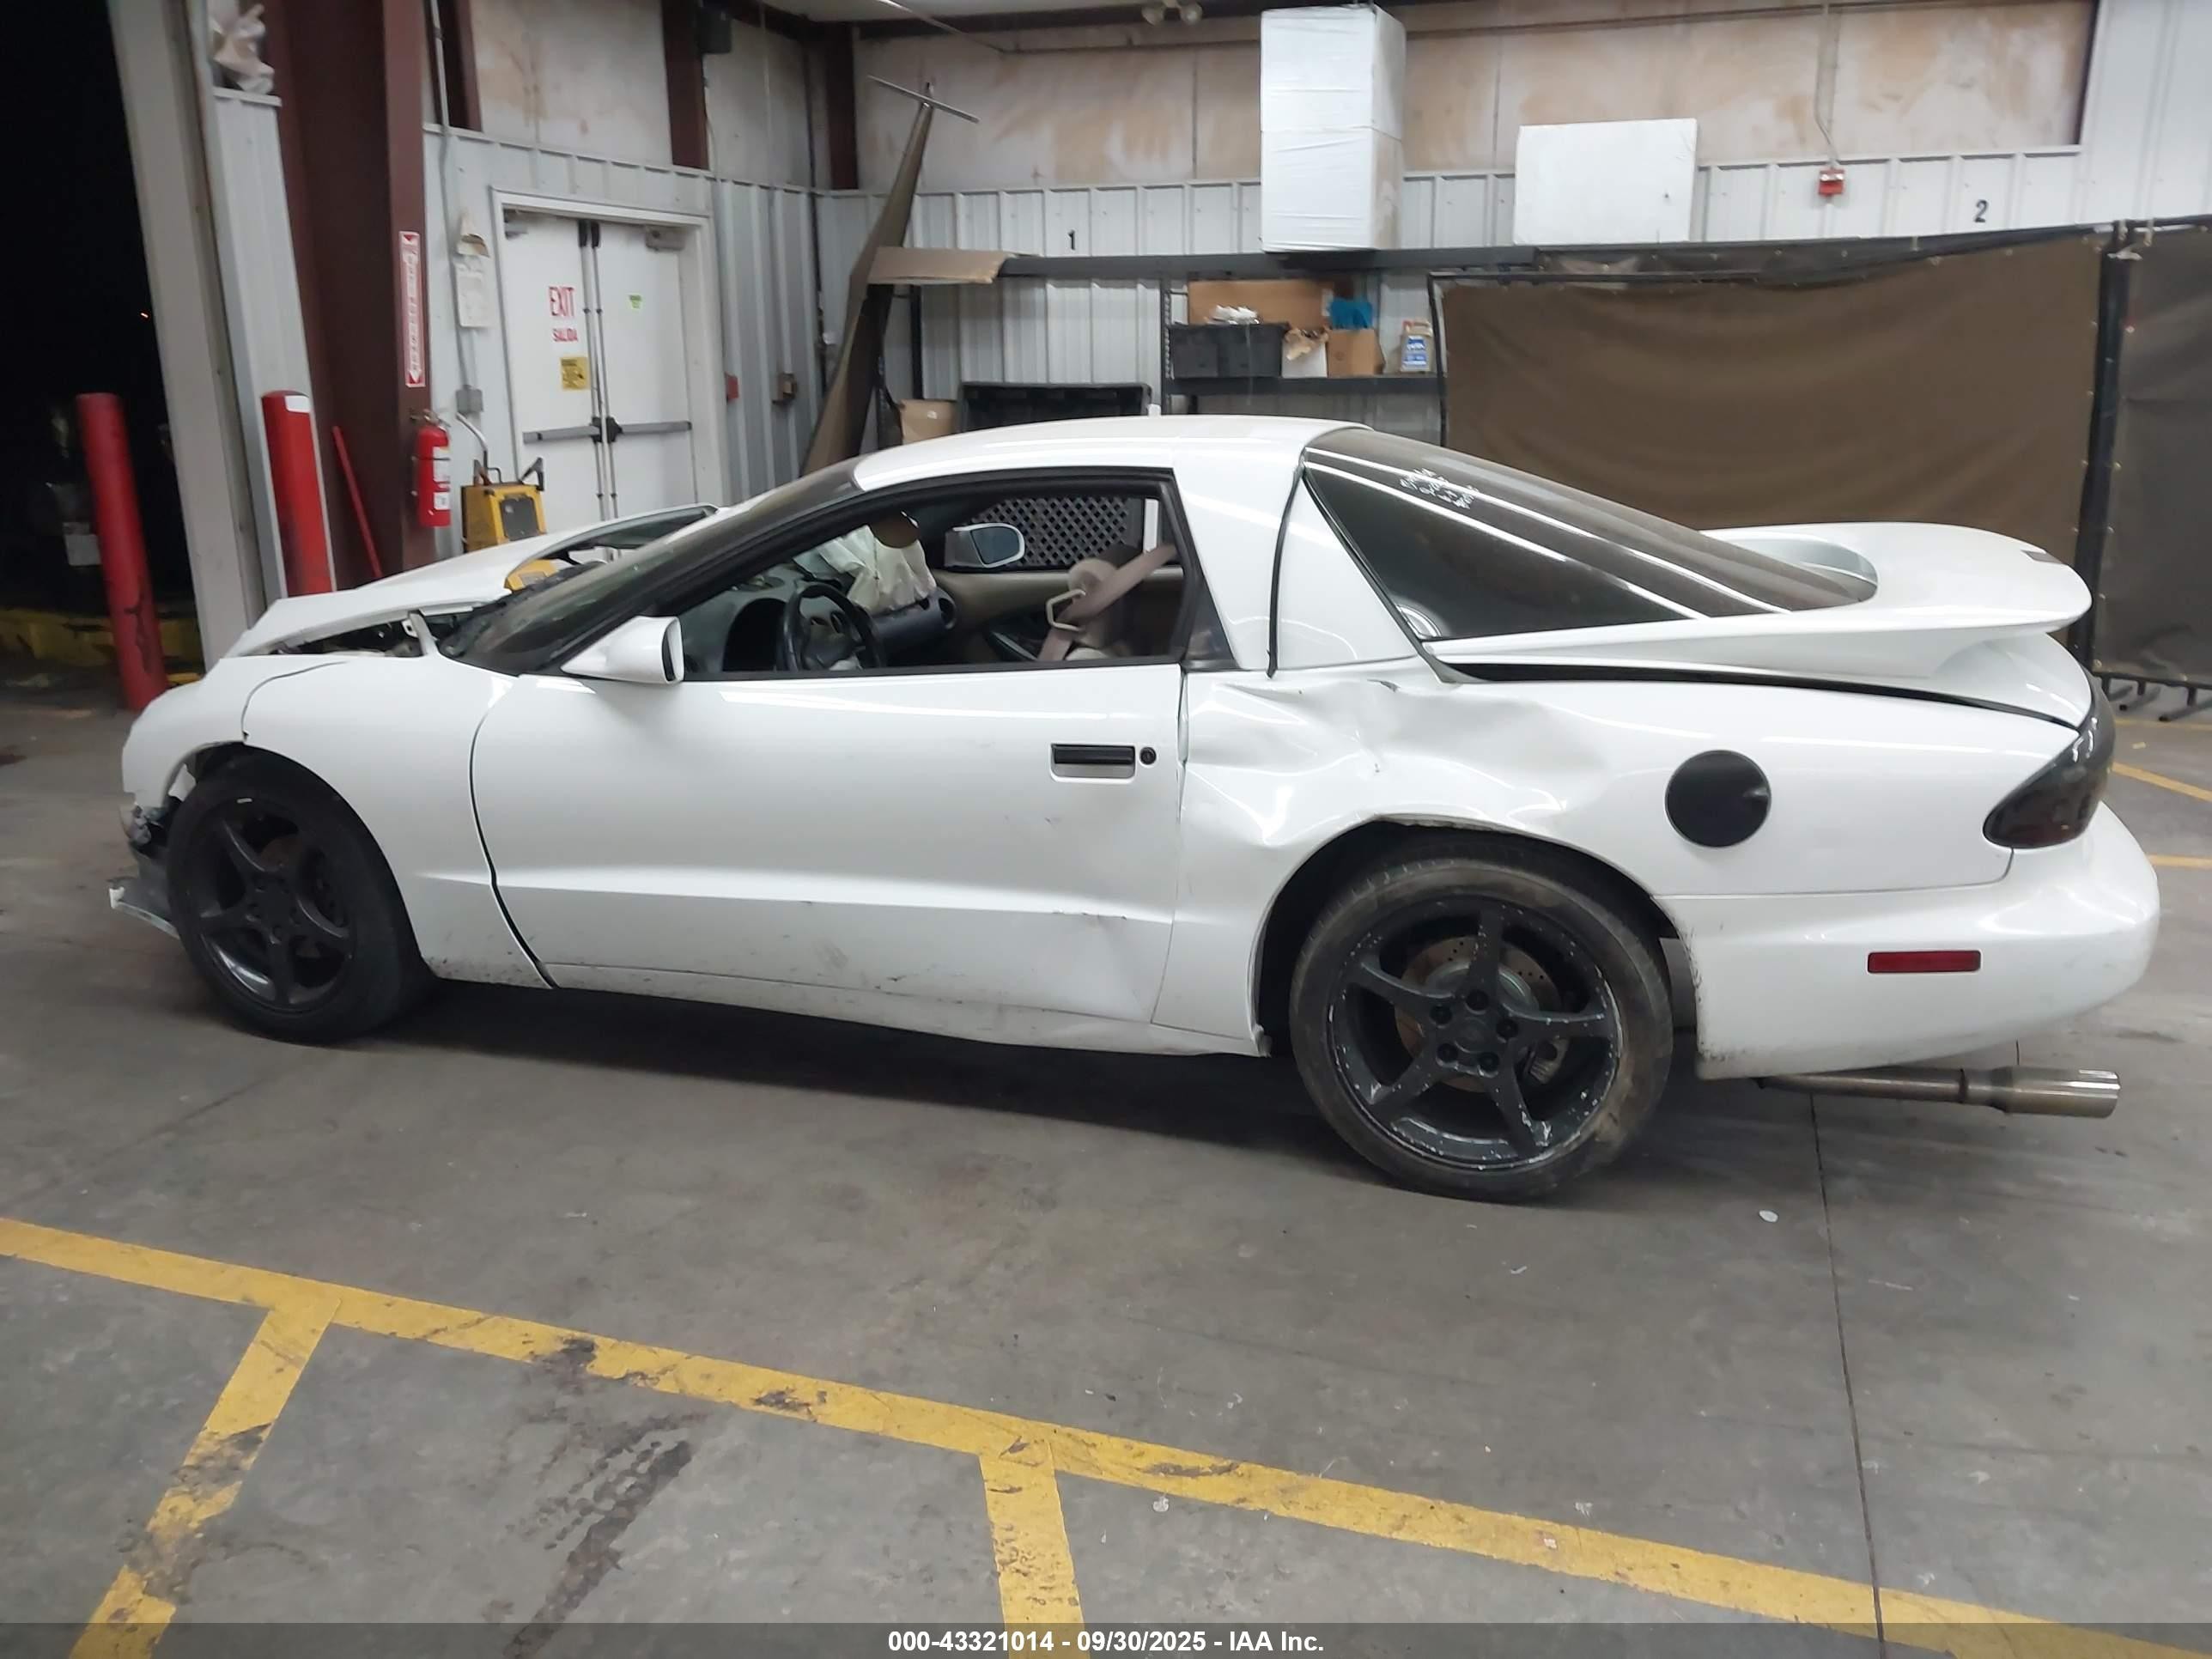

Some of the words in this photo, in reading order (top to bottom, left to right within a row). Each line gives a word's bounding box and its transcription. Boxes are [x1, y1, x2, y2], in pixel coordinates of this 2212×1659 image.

[1975, 199, 1989, 223] 2
[1067, 229, 1076, 251] 1
[549, 286, 574, 317] EXIT
[552, 328, 579, 343] SALIDA
